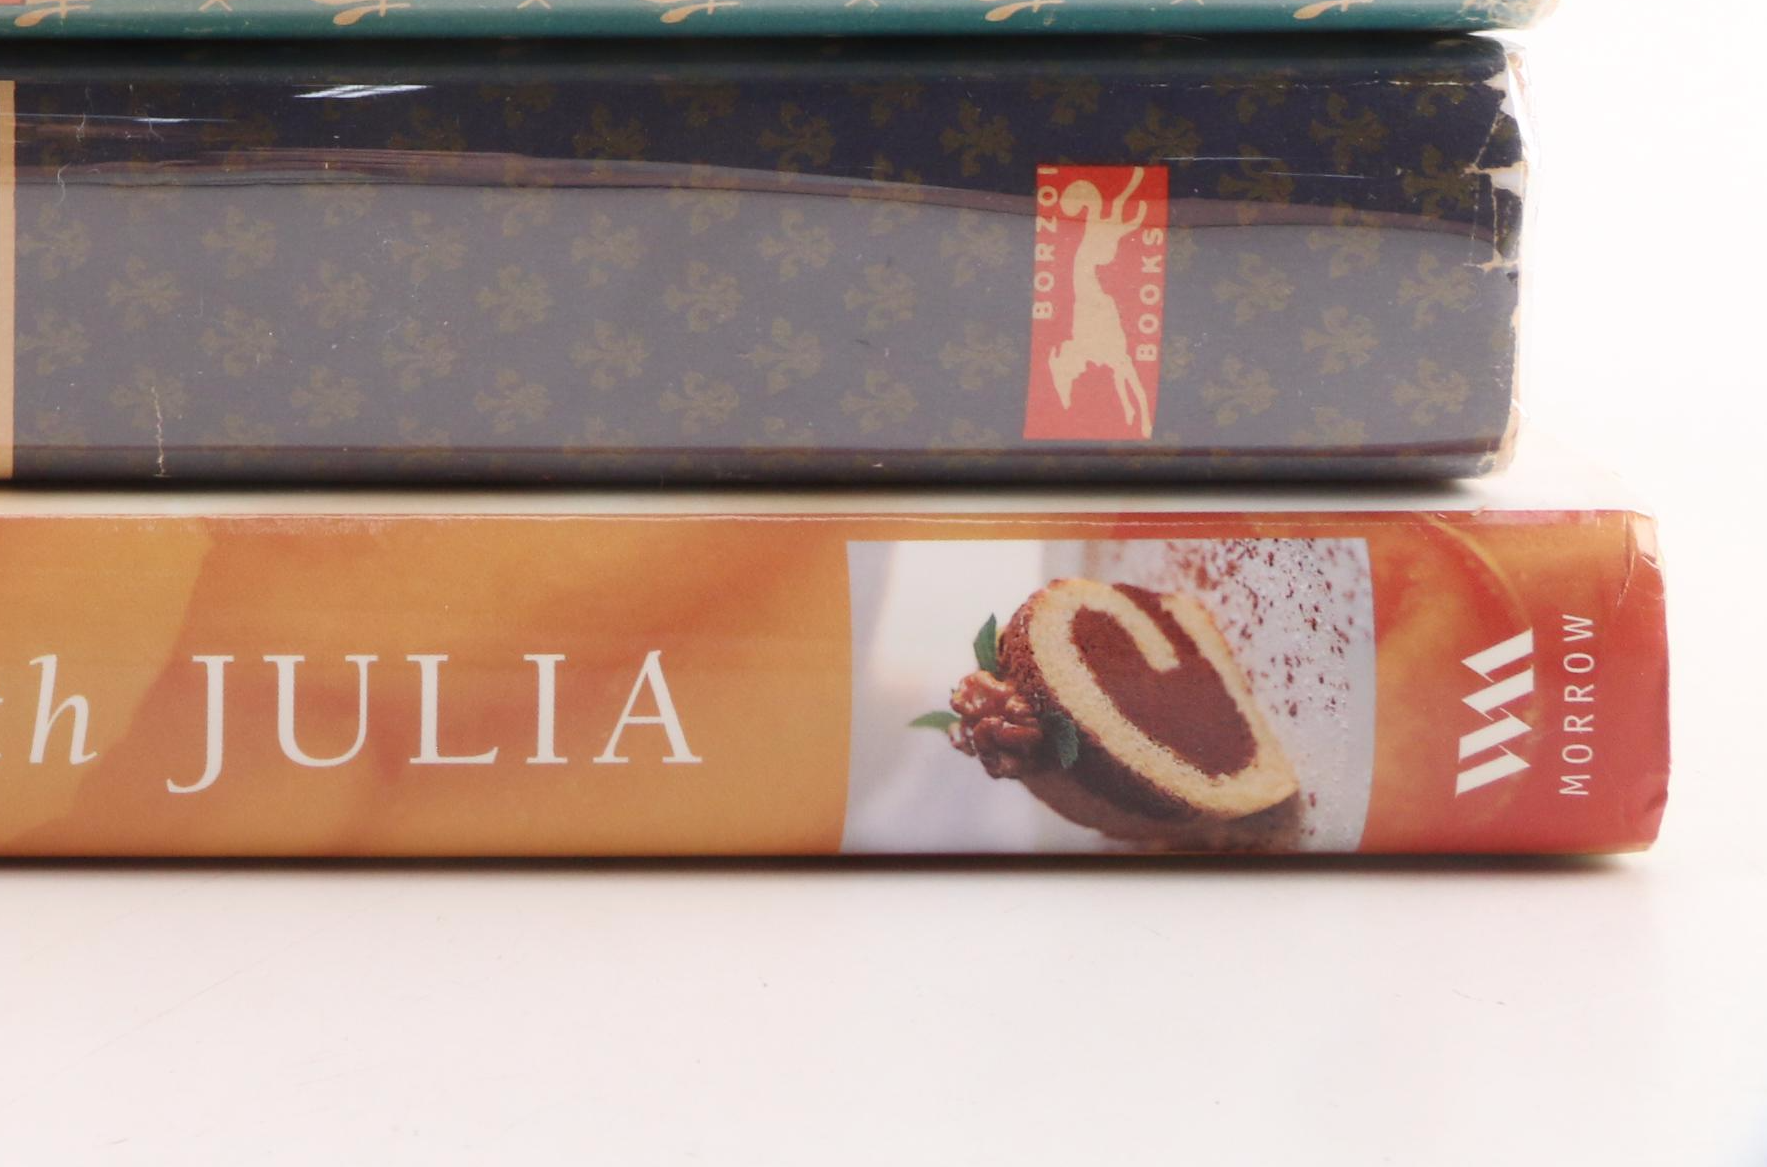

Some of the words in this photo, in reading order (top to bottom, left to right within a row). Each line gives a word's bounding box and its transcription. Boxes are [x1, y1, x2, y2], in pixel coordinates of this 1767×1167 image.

[1031, 166, 1059, 320] BORZOI
[1135, 226, 1164, 362] BOOKS
[165, 648, 703, 795] JULIA
[1558, 613, 1595, 797] MORROW
